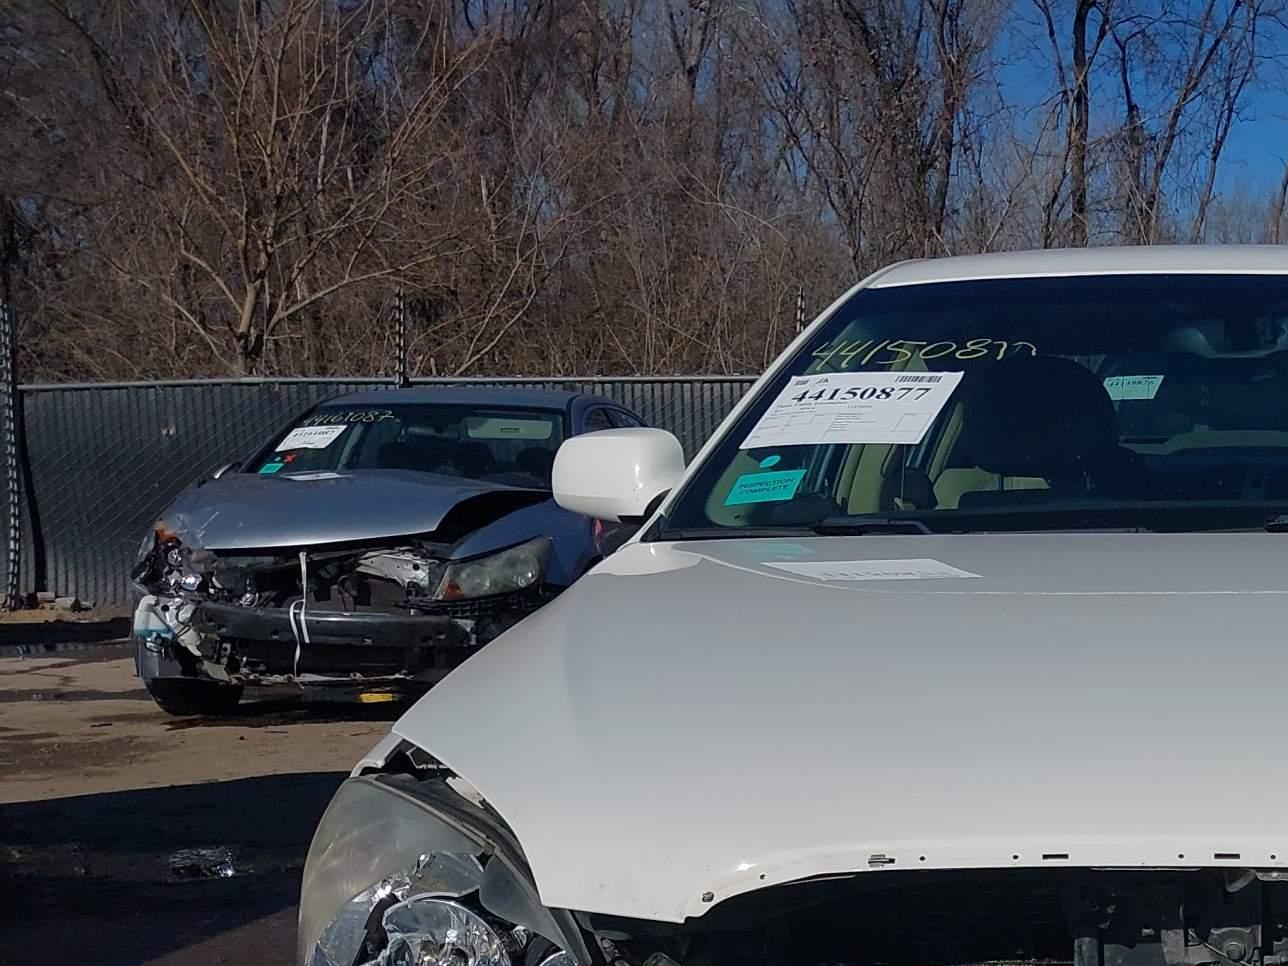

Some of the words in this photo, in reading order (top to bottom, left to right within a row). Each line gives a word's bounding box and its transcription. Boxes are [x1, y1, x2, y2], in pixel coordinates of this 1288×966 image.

[791, 386, 934, 404] 44150877
[738, 477, 795, 490] INSPECTION
[739, 484, 790, 496] COMPLETE
